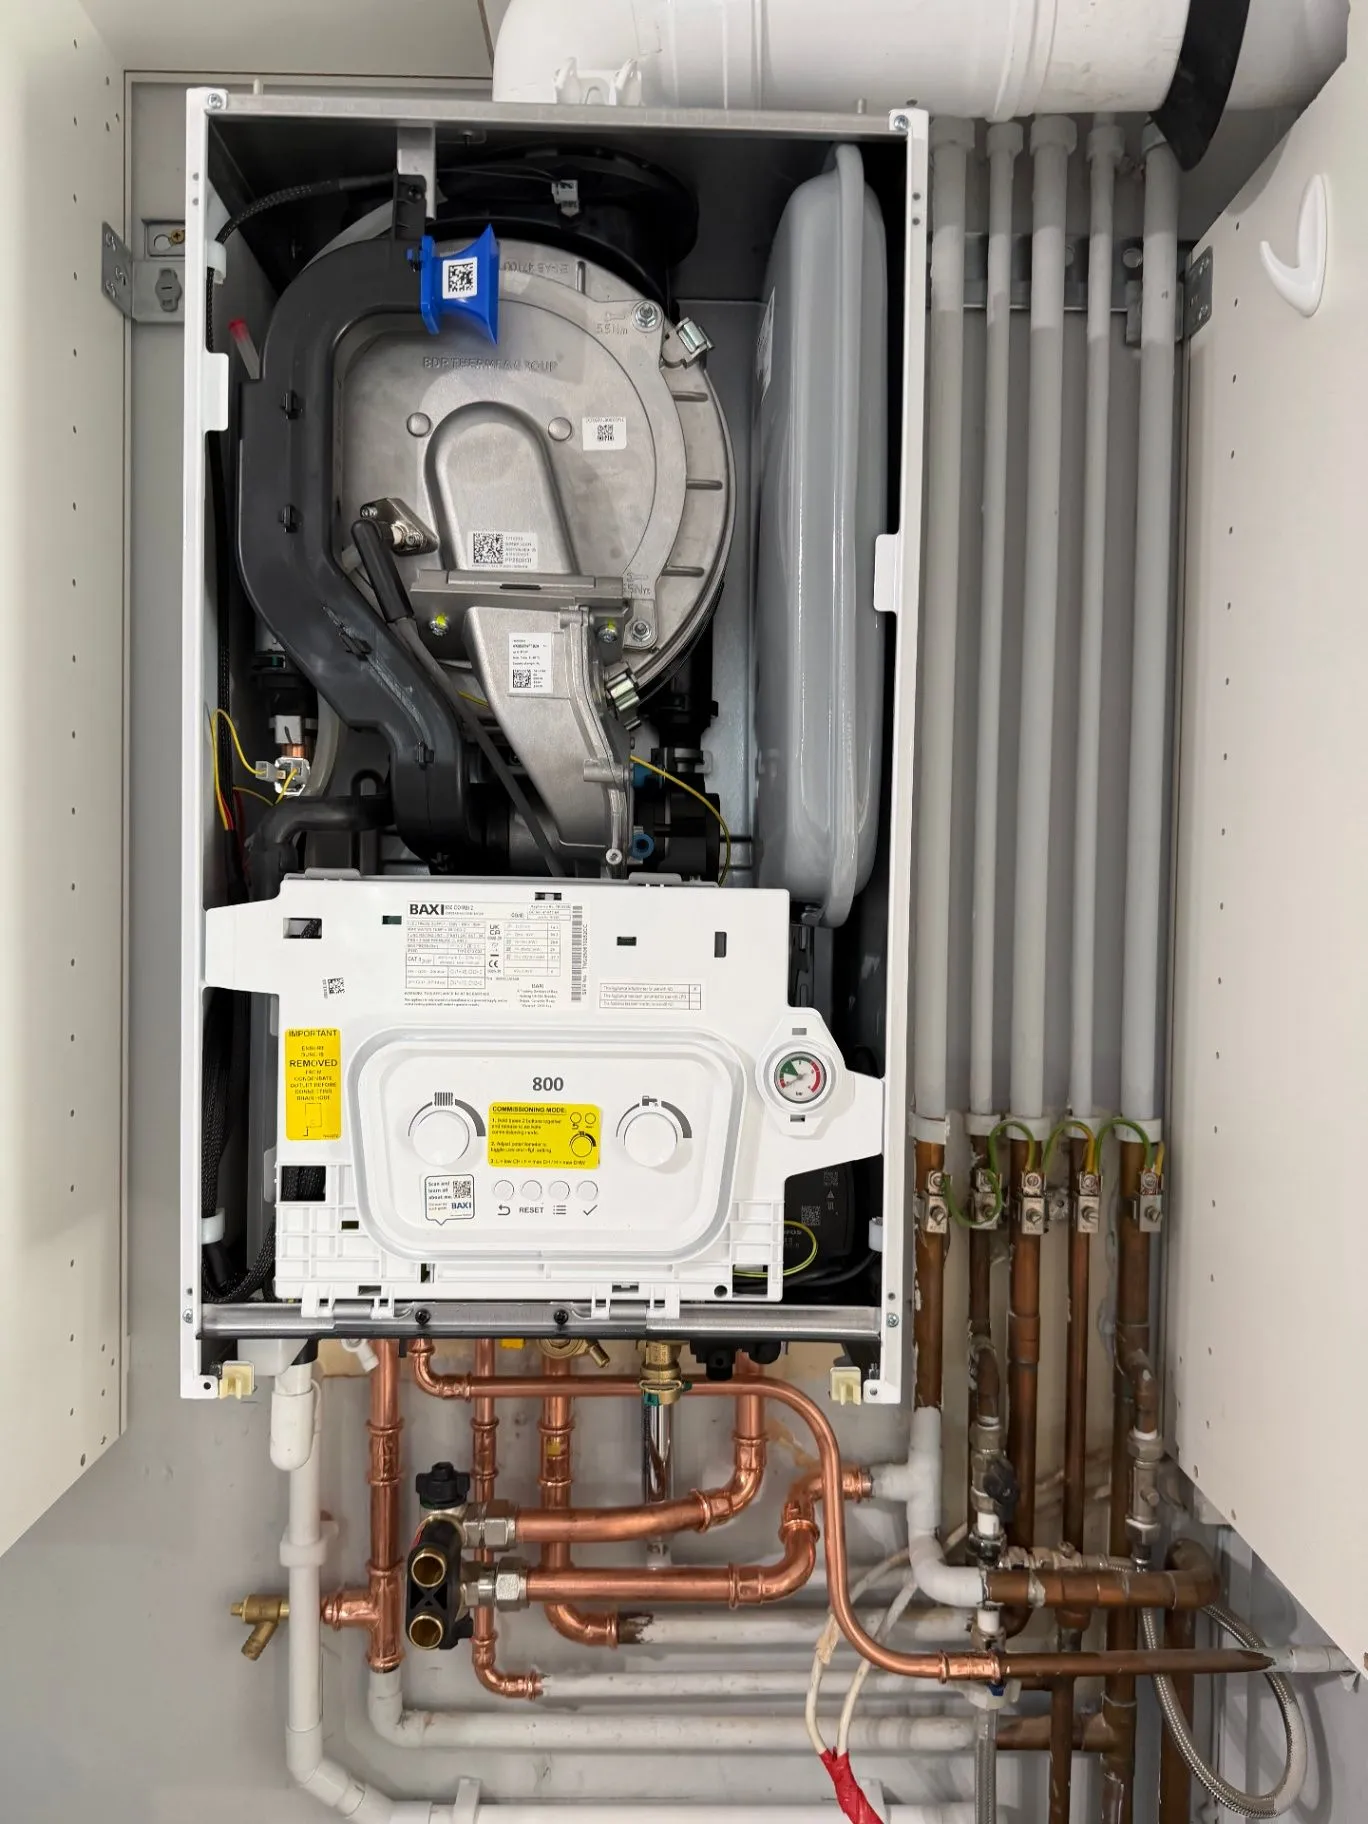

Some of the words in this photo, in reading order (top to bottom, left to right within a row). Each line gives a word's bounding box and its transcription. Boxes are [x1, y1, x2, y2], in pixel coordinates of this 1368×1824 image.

[409, 903, 444, 915] BAXI
[289, 1029, 337, 1037] IMPORTANT
[289, 1059, 338, 1067] REMOVED
[532, 1077, 564, 1091] 800
